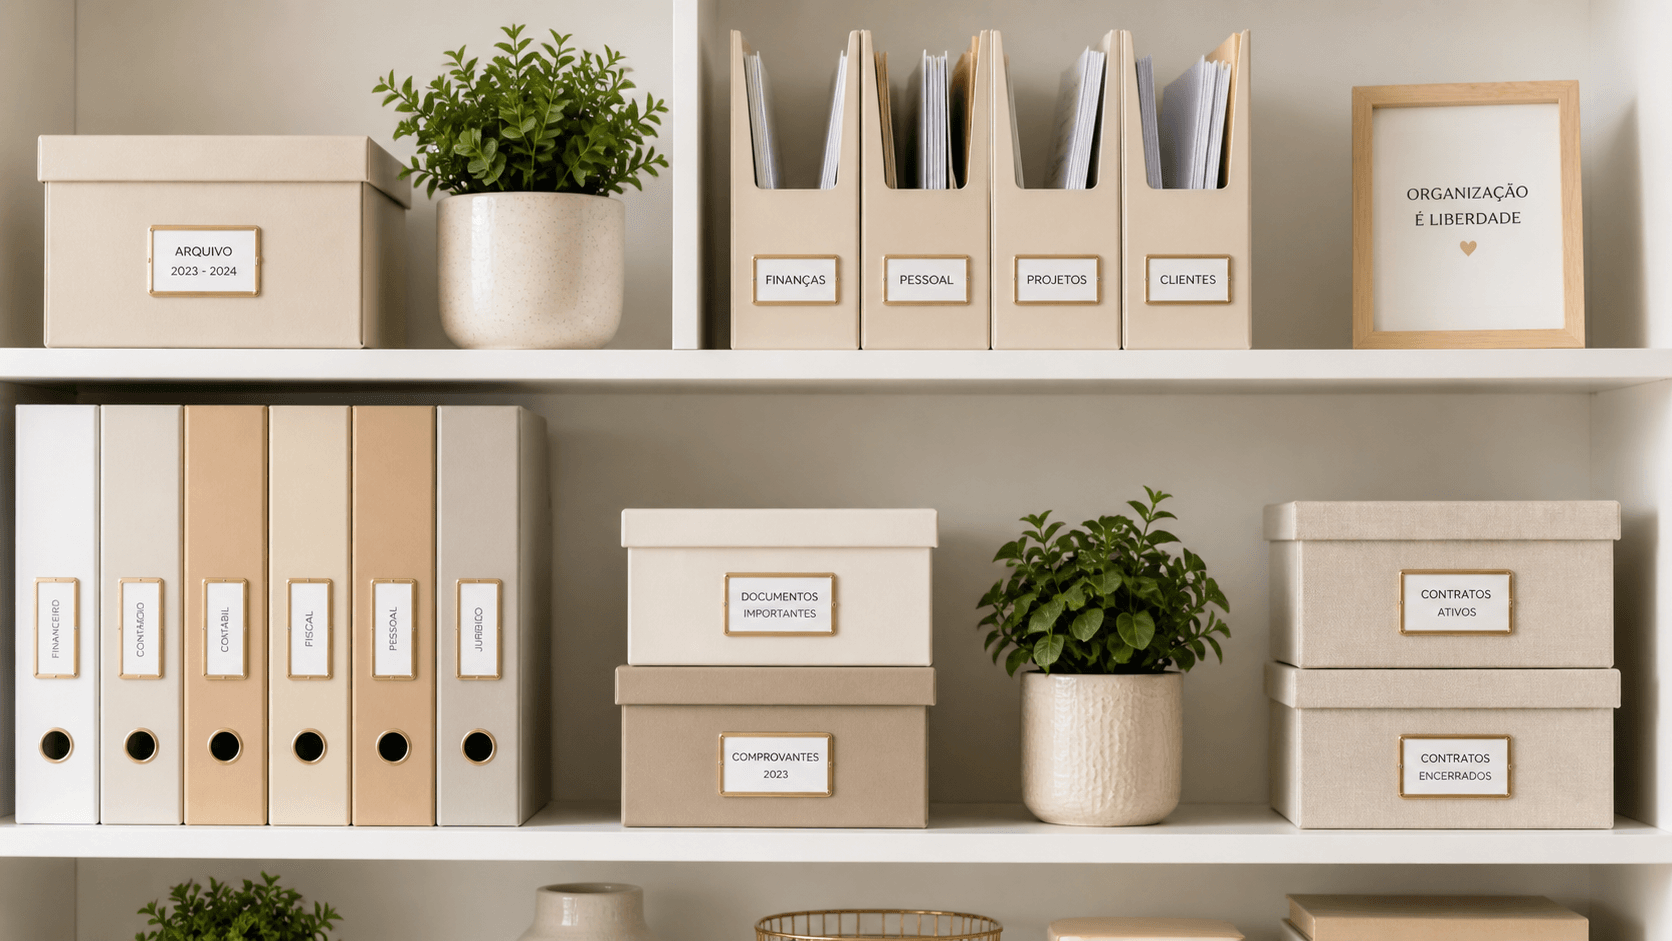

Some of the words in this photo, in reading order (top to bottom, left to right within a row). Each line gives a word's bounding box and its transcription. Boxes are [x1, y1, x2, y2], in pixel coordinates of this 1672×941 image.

[1407, 183, 1529, 202] ORGANIZAÇÃO
[1415, 211, 1424, 226] É
[1430, 211, 1521, 226] LIBERDADE
[174, 246, 233, 257] ARQUIVO
[171, 265, 198, 276] 2023
[210, 265, 237, 276] 2024
[765, 274, 826, 287] FINANÇAS
[899, 274, 954, 285] PESSOAL
[1027, 274, 1088, 285] PROJETOS
[1160, 274, 1217, 285] CLIENTES
[741, 592, 819, 602] DOCUMENTOS
[1421, 589, 1492, 600] CONTRATOS
[743, 609, 817, 619] IMPORTANTES
[1437, 607, 1477, 617] ATIVOS
[51, 599, 60, 659] FINANCEIRO
[304, 611, 314, 647] FISCAL
[388, 606, 398, 651] PESSOAL
[731, 752, 820, 762] COMPROVANTES
[1420, 753, 1491, 764] CONTRATOS
[763, 770, 789, 779] 2023
[1419, 771, 1492, 781] ENCERRADOS
